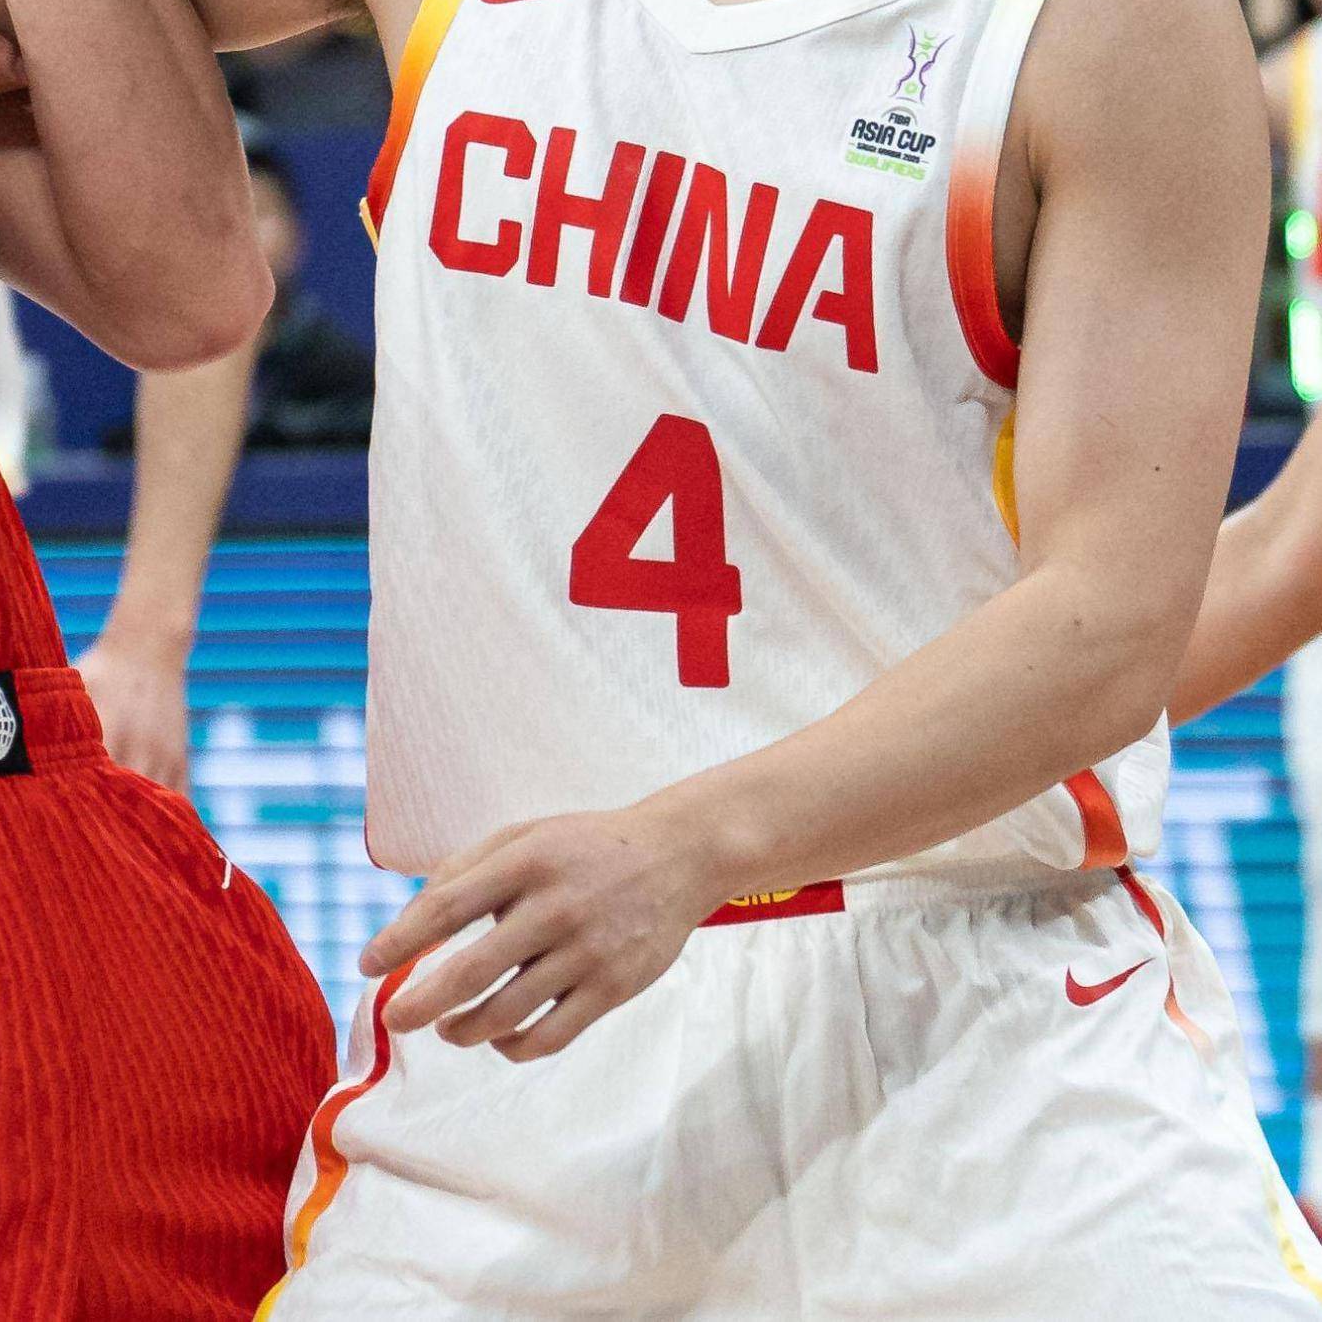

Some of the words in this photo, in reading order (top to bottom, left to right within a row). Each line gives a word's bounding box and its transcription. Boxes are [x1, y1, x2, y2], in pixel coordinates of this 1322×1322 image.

[851, 118, 896, 147] ASIA
[897, 129, 936, 154] CUP
[888, 112, 911, 127] FIBA
[429, 110, 878, 374] CHINA
[569, 412, 743, 688] 4
